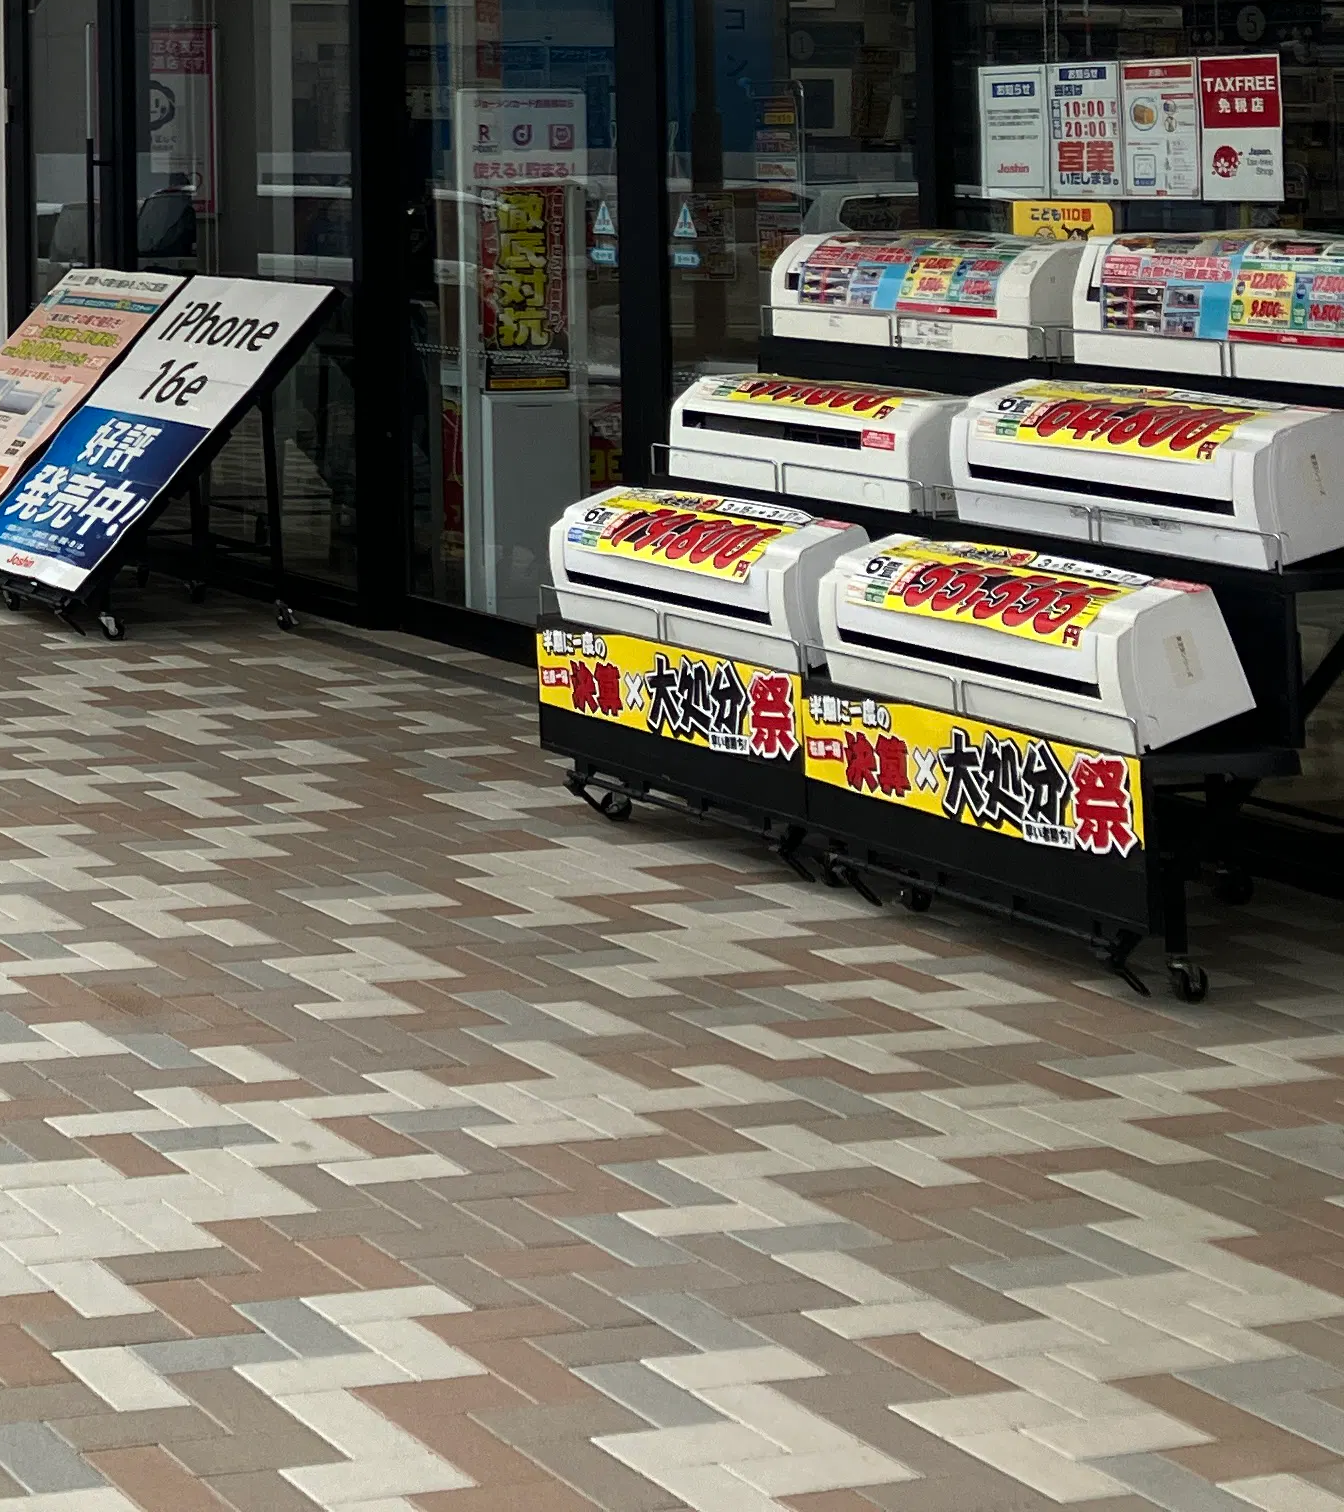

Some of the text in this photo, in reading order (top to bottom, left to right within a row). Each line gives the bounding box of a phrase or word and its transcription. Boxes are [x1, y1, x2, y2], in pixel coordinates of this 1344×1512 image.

[995, 83, 1031, 97] お知らせ
[1202, 75, 1276, 93] TAXFREE
[1063, 100, 1105, 118] 10:00
[1217, 96, 1265, 114] 免税店
[1064, 120, 1107, 138] 20:00
[996, 162, 1031, 175] Joshin
[1057, 140, 1115, 173] 営業
[158, 300, 280, 352] iPhone
[138, 359, 209, 407] 16e
[76, 417, 163, 473] 好評
[4, 463, 147, 537] 発売中!
[6, 552, 35, 568] Joshin
[542, 629, 607, 659] 半期に一度の
[809, 694, 891, 731] 半期に一度の
